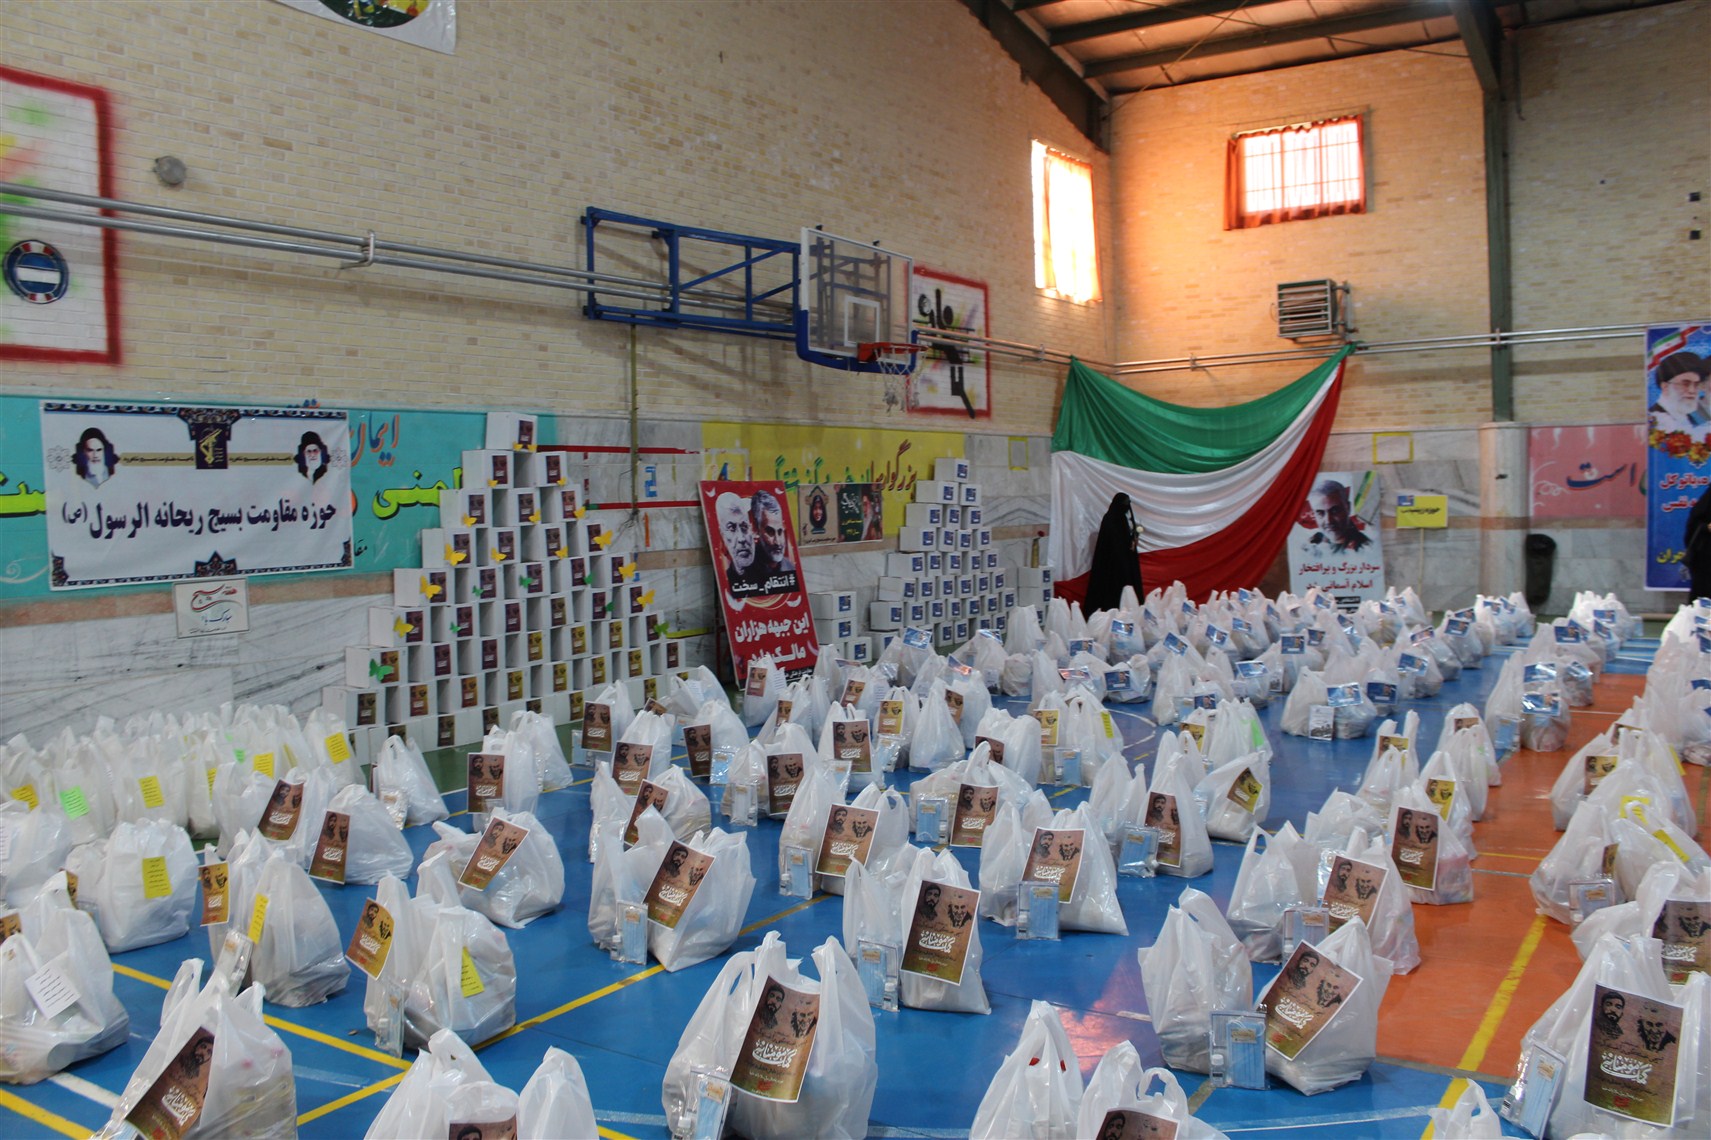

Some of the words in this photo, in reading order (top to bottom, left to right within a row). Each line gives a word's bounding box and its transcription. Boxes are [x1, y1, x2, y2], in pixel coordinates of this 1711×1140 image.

[1567, 461, 1637, 491] است
[62, 502, 88, 523] (ص)
[89, 502, 149, 539] الرسول
[154, 501, 203, 535] ریحانه
[208, 507, 243, 533] بسیج
[247, 498, 298, 531] مقاومت
[301, 502, 336, 529] حوزه
[1338, 562, 1358, 574] بزرگ
[1358, 562, 1380, 574] سردار
[1321, 578, 1350, 592] آسمانی
[1351, 579, 1373, 592] اسلام
[735, 620, 767, 642] هزاران
[768, 619, 792, 637] جبهه
[793, 612, 810, 635] این
